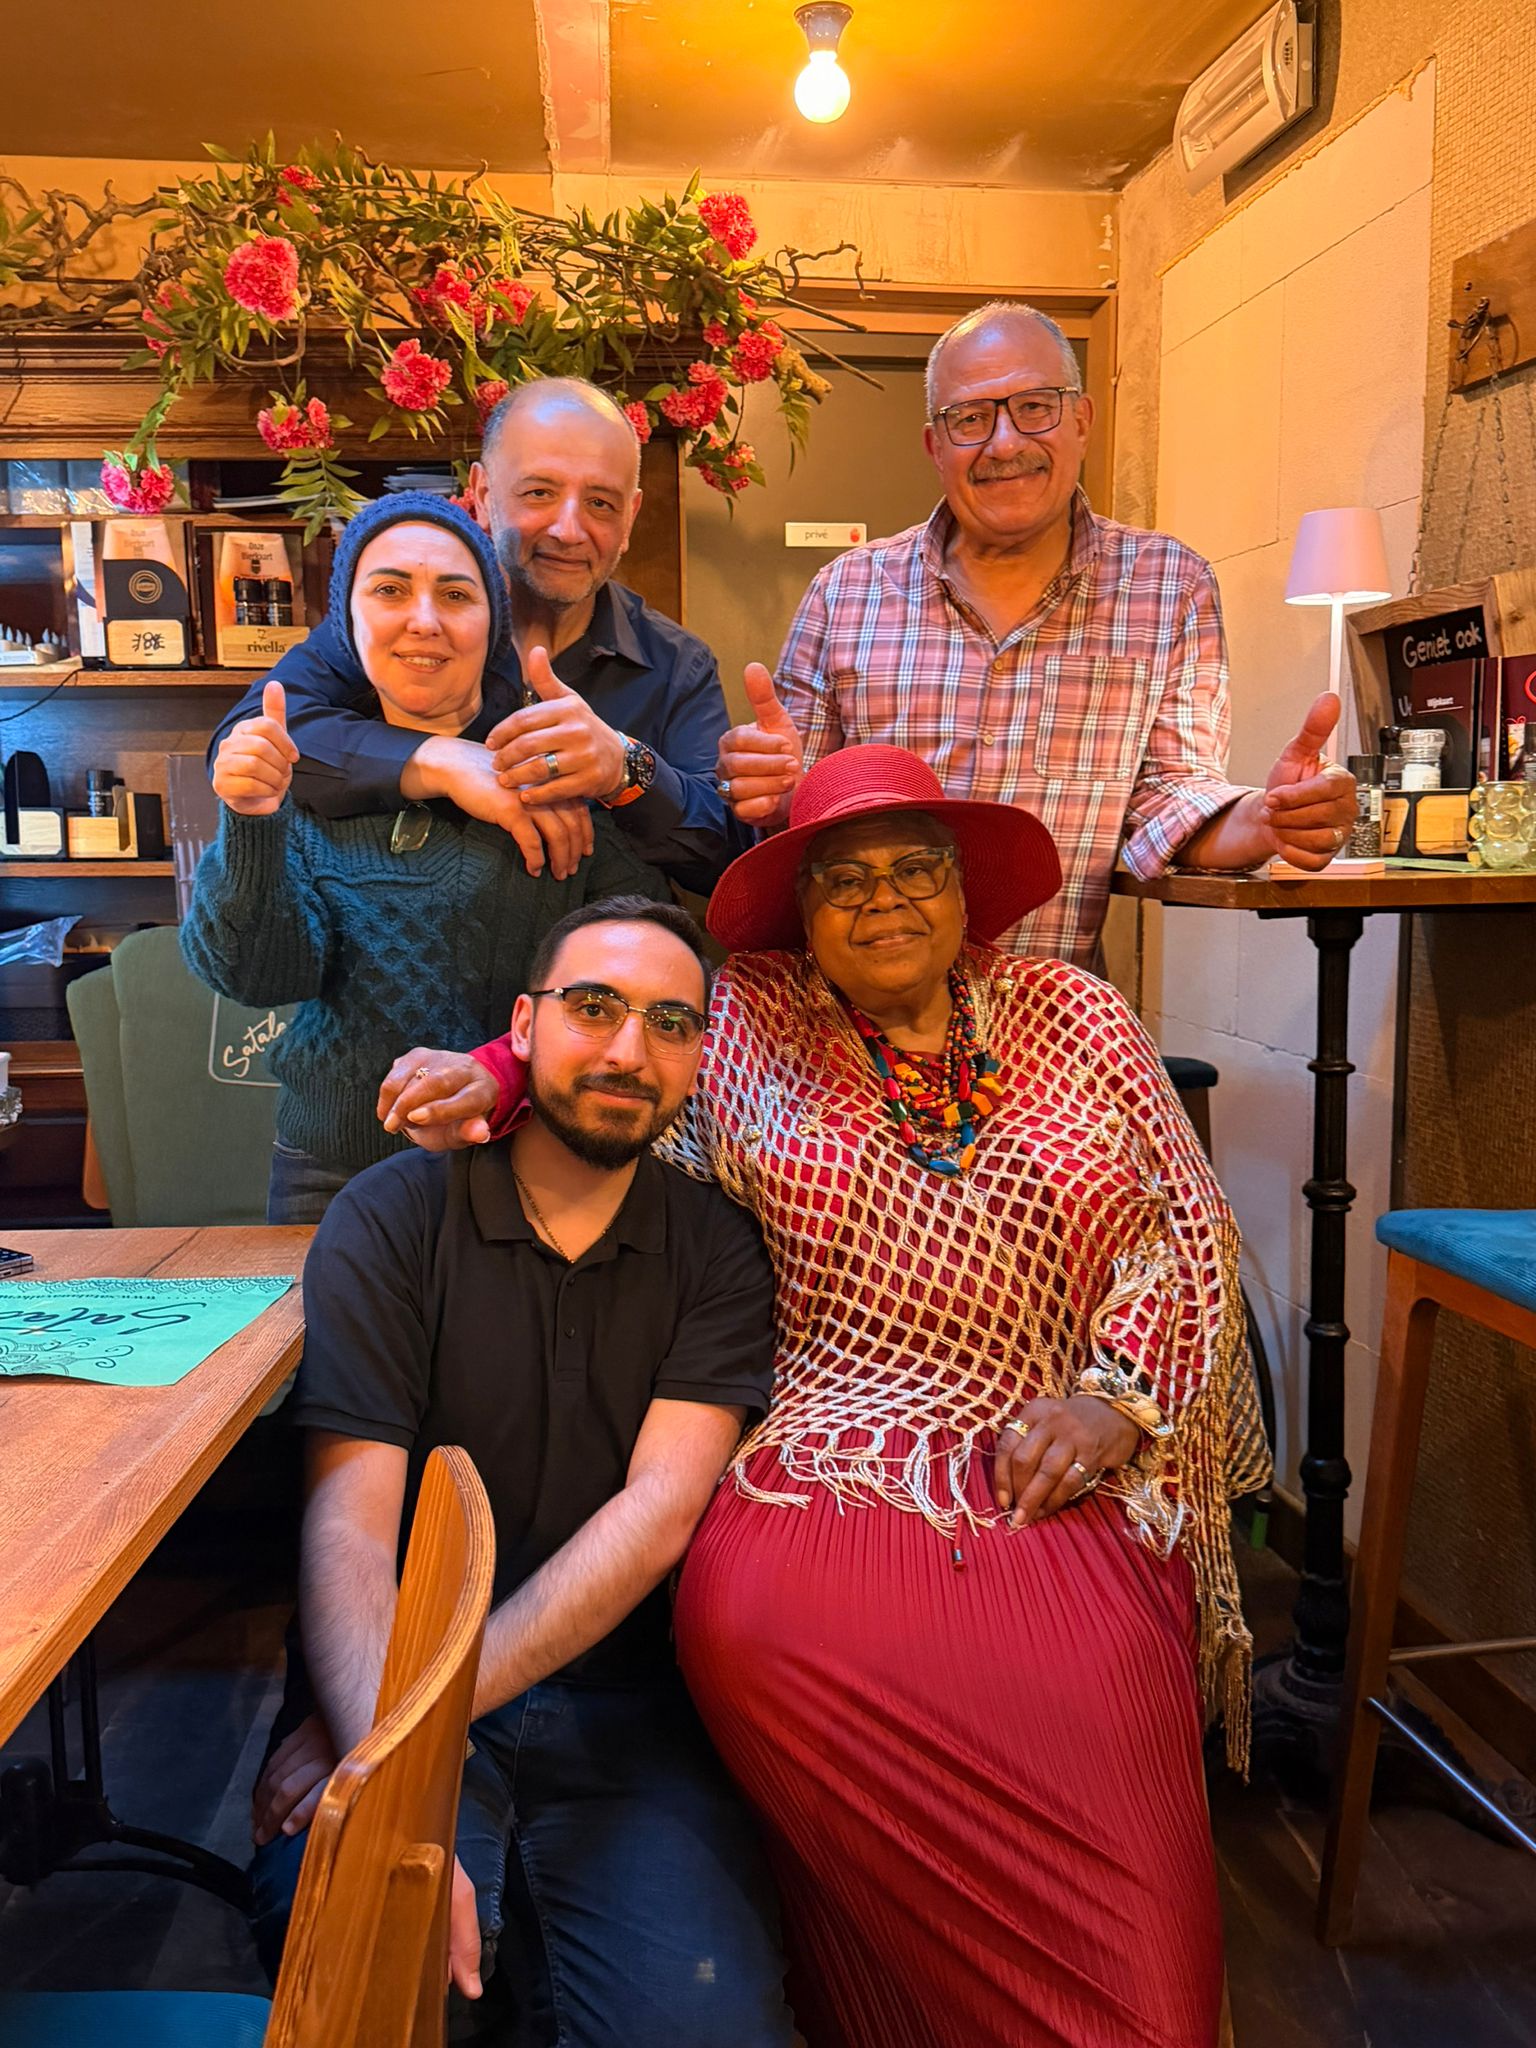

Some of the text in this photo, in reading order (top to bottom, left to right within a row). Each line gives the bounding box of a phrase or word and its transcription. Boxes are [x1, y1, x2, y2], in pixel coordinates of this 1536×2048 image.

[804, 528, 829, 541] privé
[247, 640, 287, 653] rivella
[1402, 621, 1483, 668] Geniet ook
[1398, 695, 1413, 717] U
